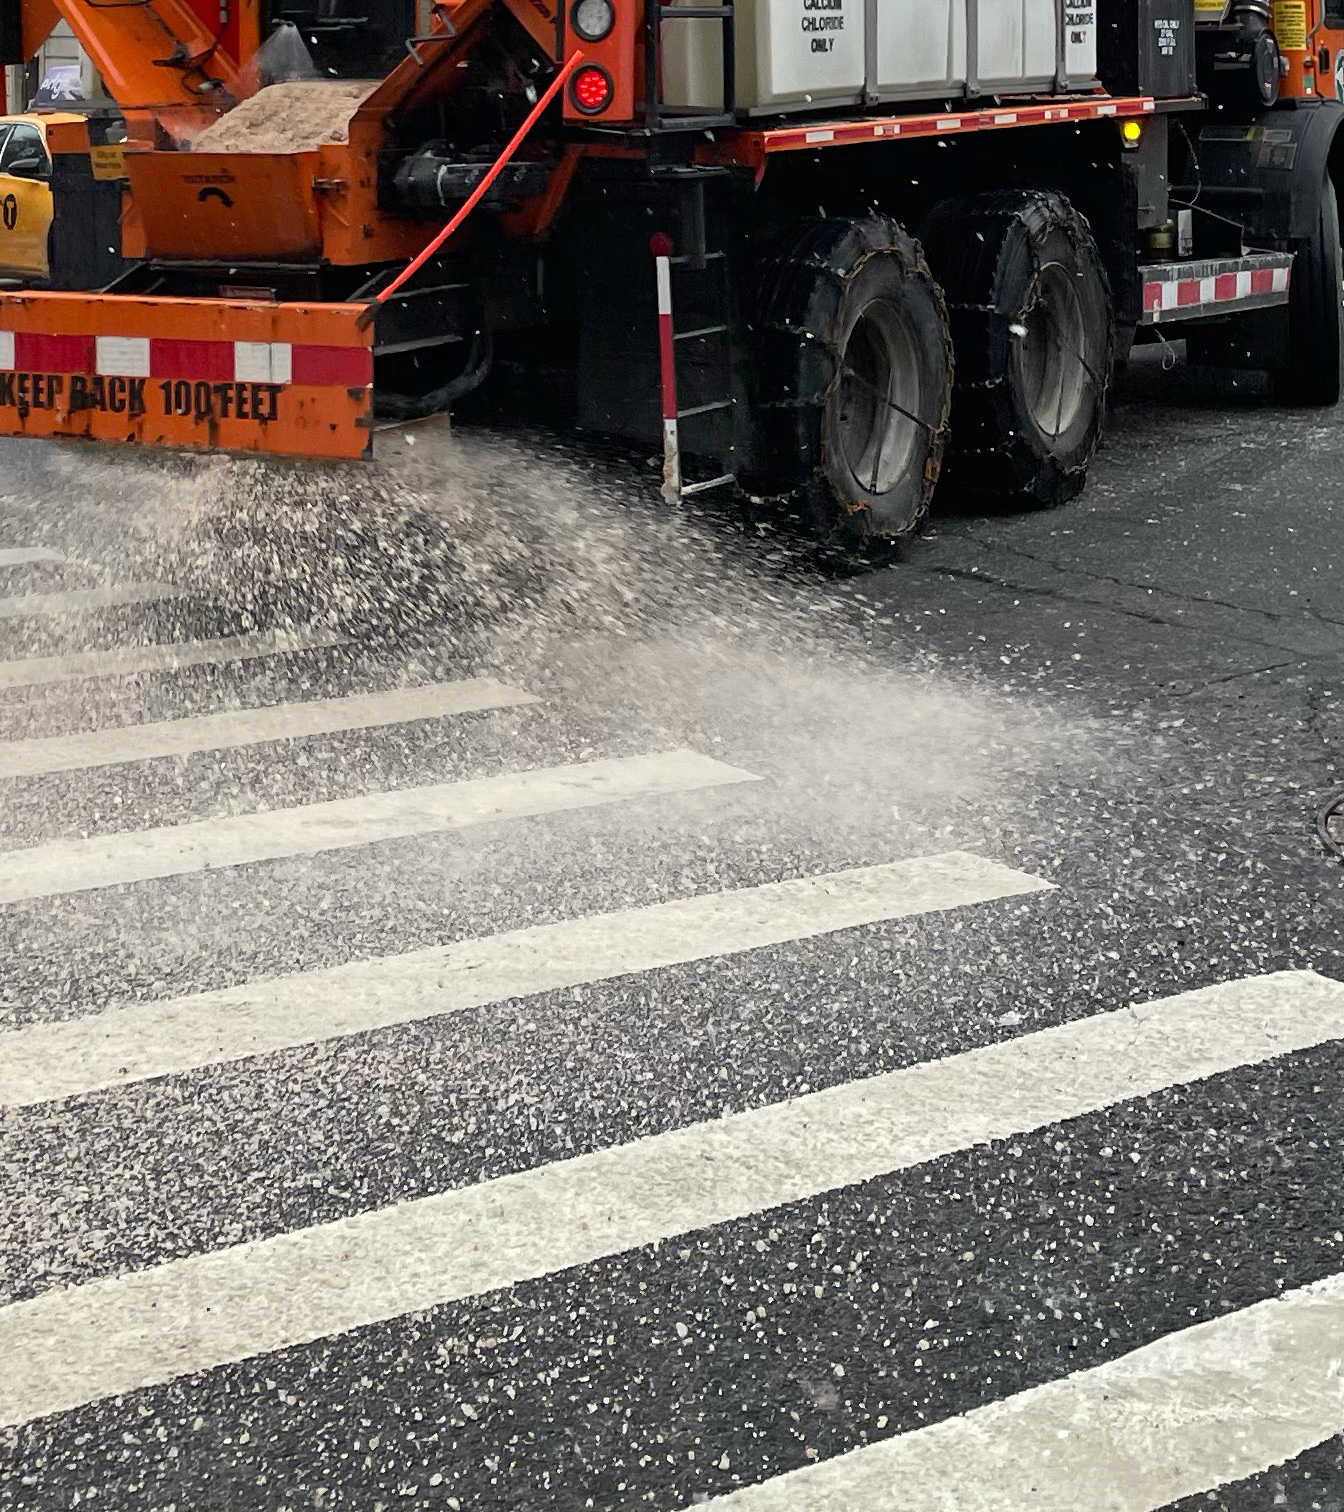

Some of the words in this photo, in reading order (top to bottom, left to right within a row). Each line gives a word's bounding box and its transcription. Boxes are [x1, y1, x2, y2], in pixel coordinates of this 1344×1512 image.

[801, 16, 844, 32] CHLORIDE
[810, 38, 835, 53] ONLY
[69, 375, 148, 415] BACK
[159, 379, 213, 418] 100
[213, 383, 284, 420] FEET
